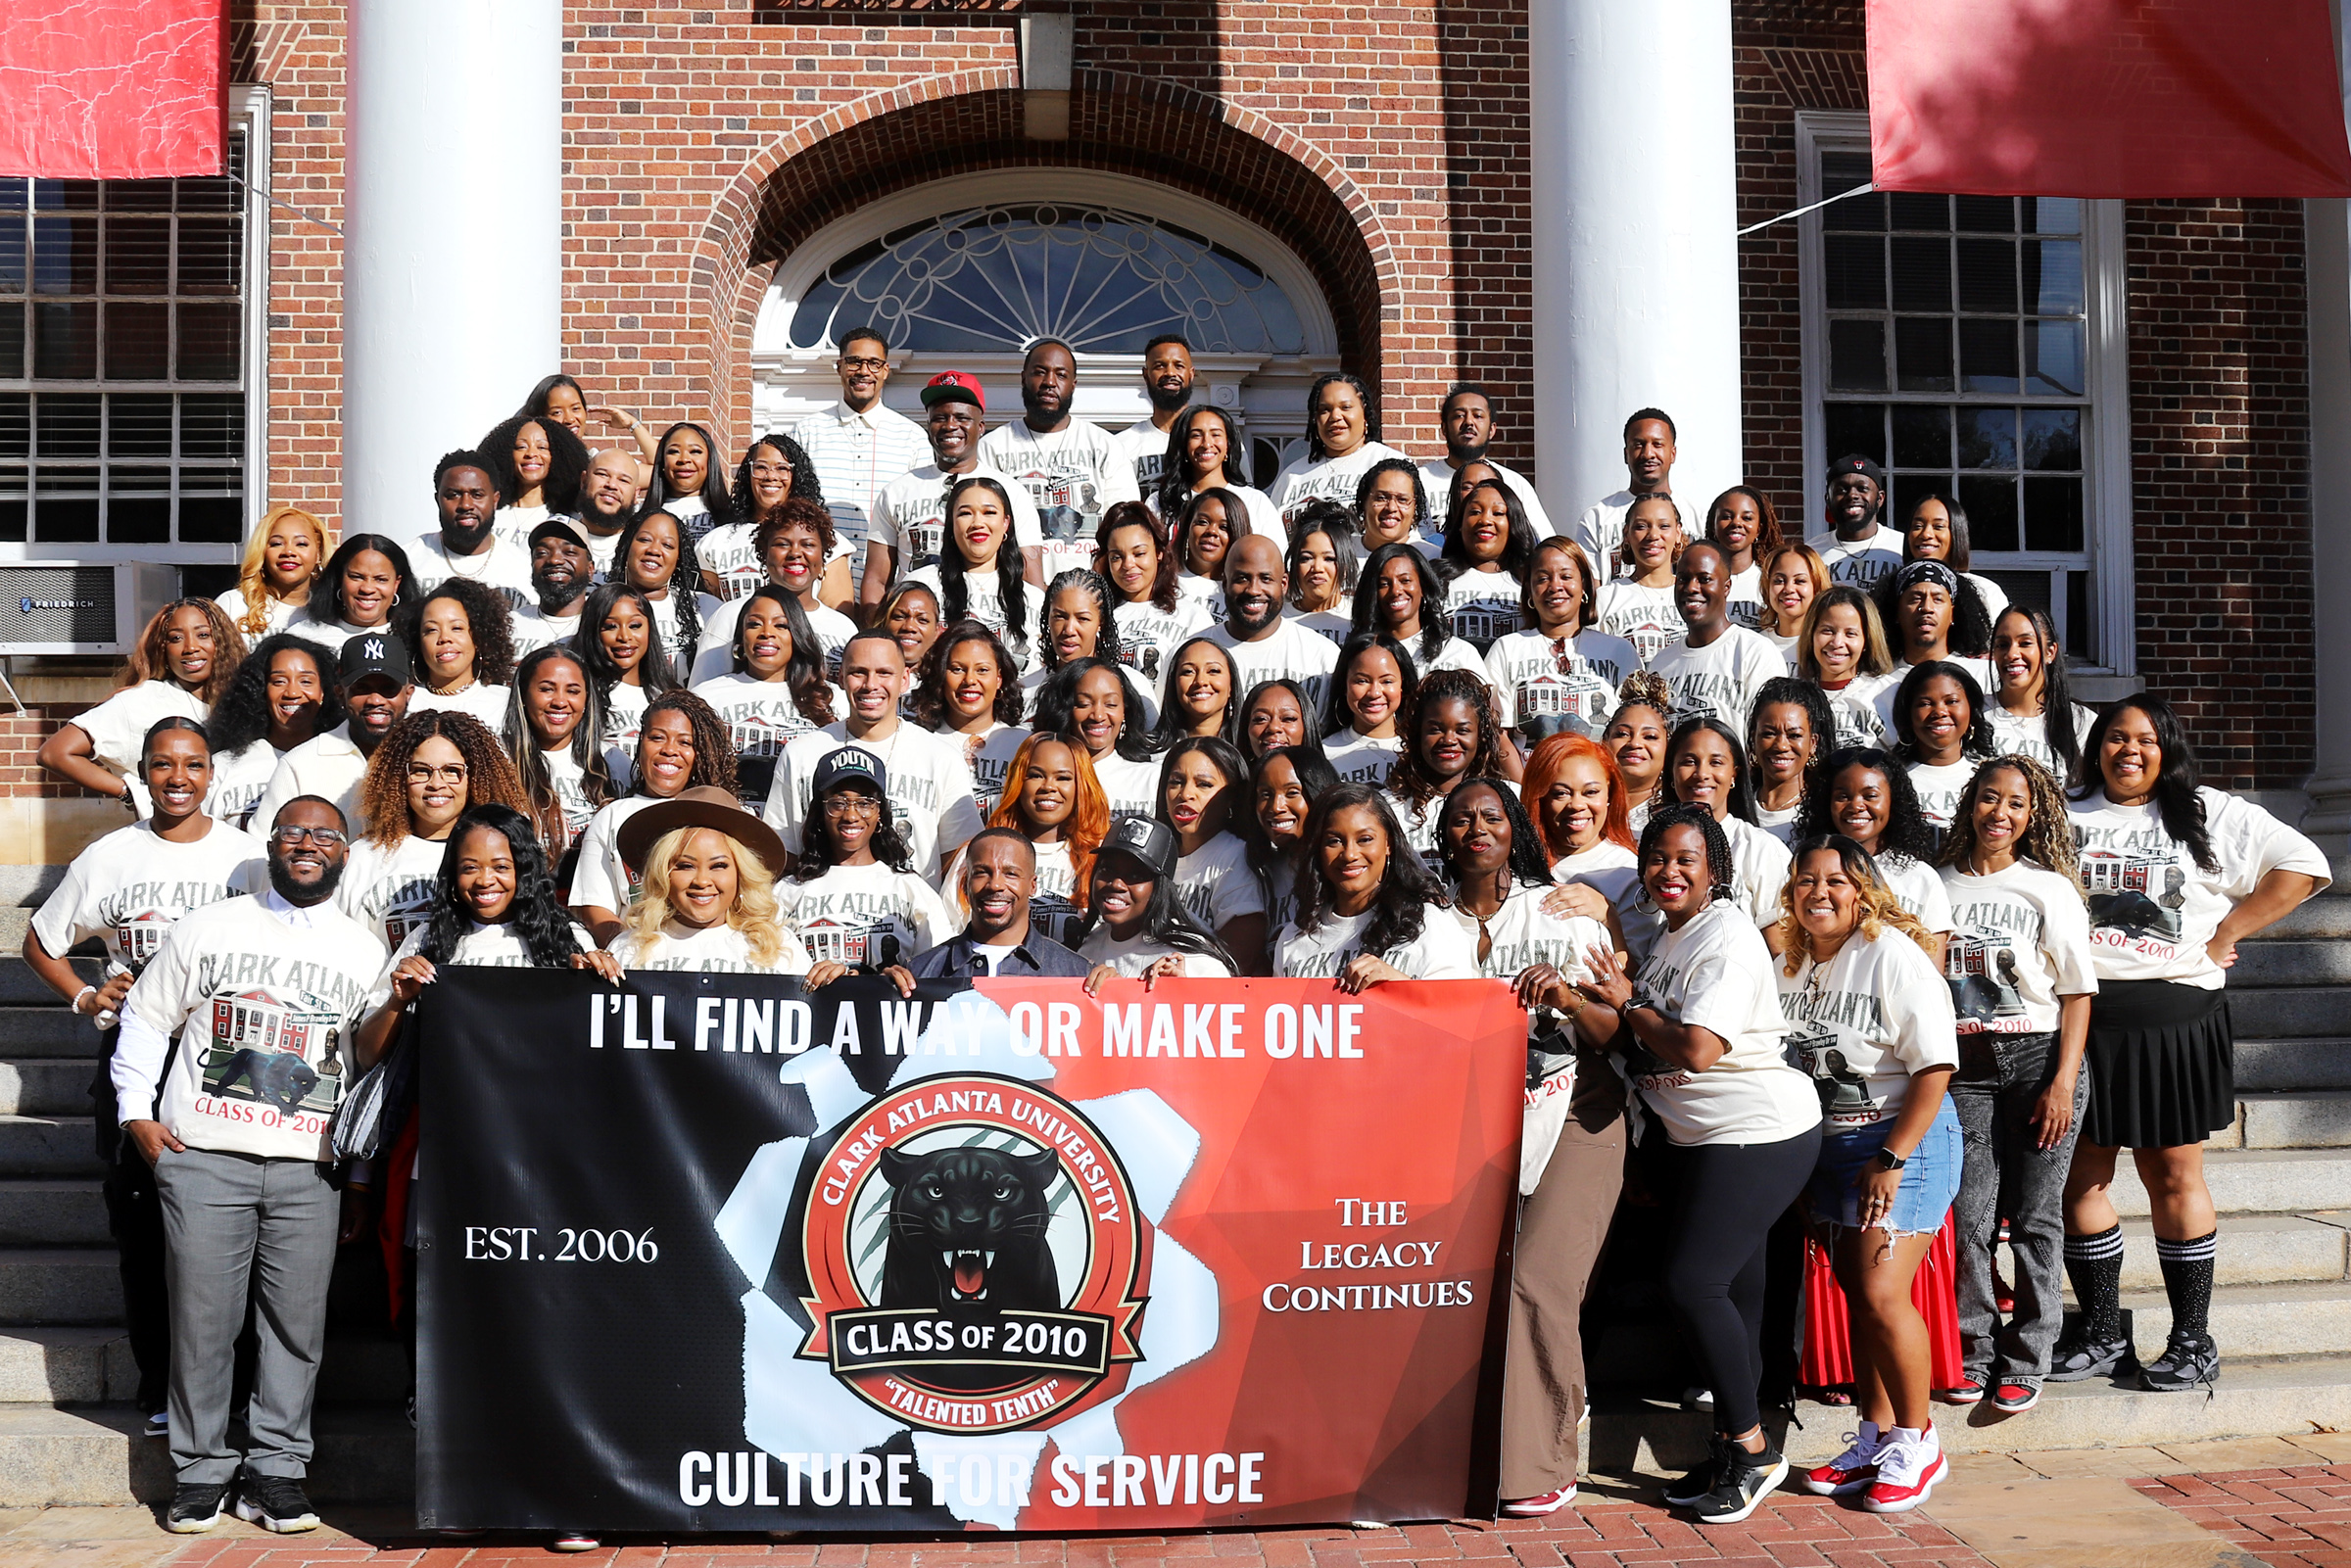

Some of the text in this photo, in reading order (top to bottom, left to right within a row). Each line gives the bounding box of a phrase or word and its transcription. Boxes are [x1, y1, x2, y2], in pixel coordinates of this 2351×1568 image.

[1280, 477, 1323, 506] LARK
[1324, 473, 1361, 490] ATLA
[1075, 543, 1099, 554] 201
[1442, 591, 1482, 607] ARK
[1508, 658, 1554, 685] LARK
[1570, 658, 1620, 692] TLANTA
[723, 700, 766, 722] ARK
[831, 750, 876, 777] YOUTH
[1341, 762, 1380, 783] ARK
[887, 773, 938, 812] LANTA
[99, 881, 228, 928] CLARK ATLA
[361, 874, 439, 921] LARK
[790, 893, 835, 921] ARK
[2108, 933, 2131, 947] OF
[199, 953, 281, 999] CLARK
[590, 993, 1365, 1060] I'LL FIND A WAY OR MAKE ONE
[1968, 1019, 2033, 1034] OF 2010
[195, 1097, 255, 1123] CLASS
[262, 1110, 286, 1129] OF
[821, 1090, 1121, 1224] CLARK ATLANTA UNIVERSITY
[464, 1226, 659, 1263] EST. 2006
[846, 1319, 1087, 1357] CLASS OF 2010
[679, 1449, 1265, 1507] CULTURE FOR SERVICE
